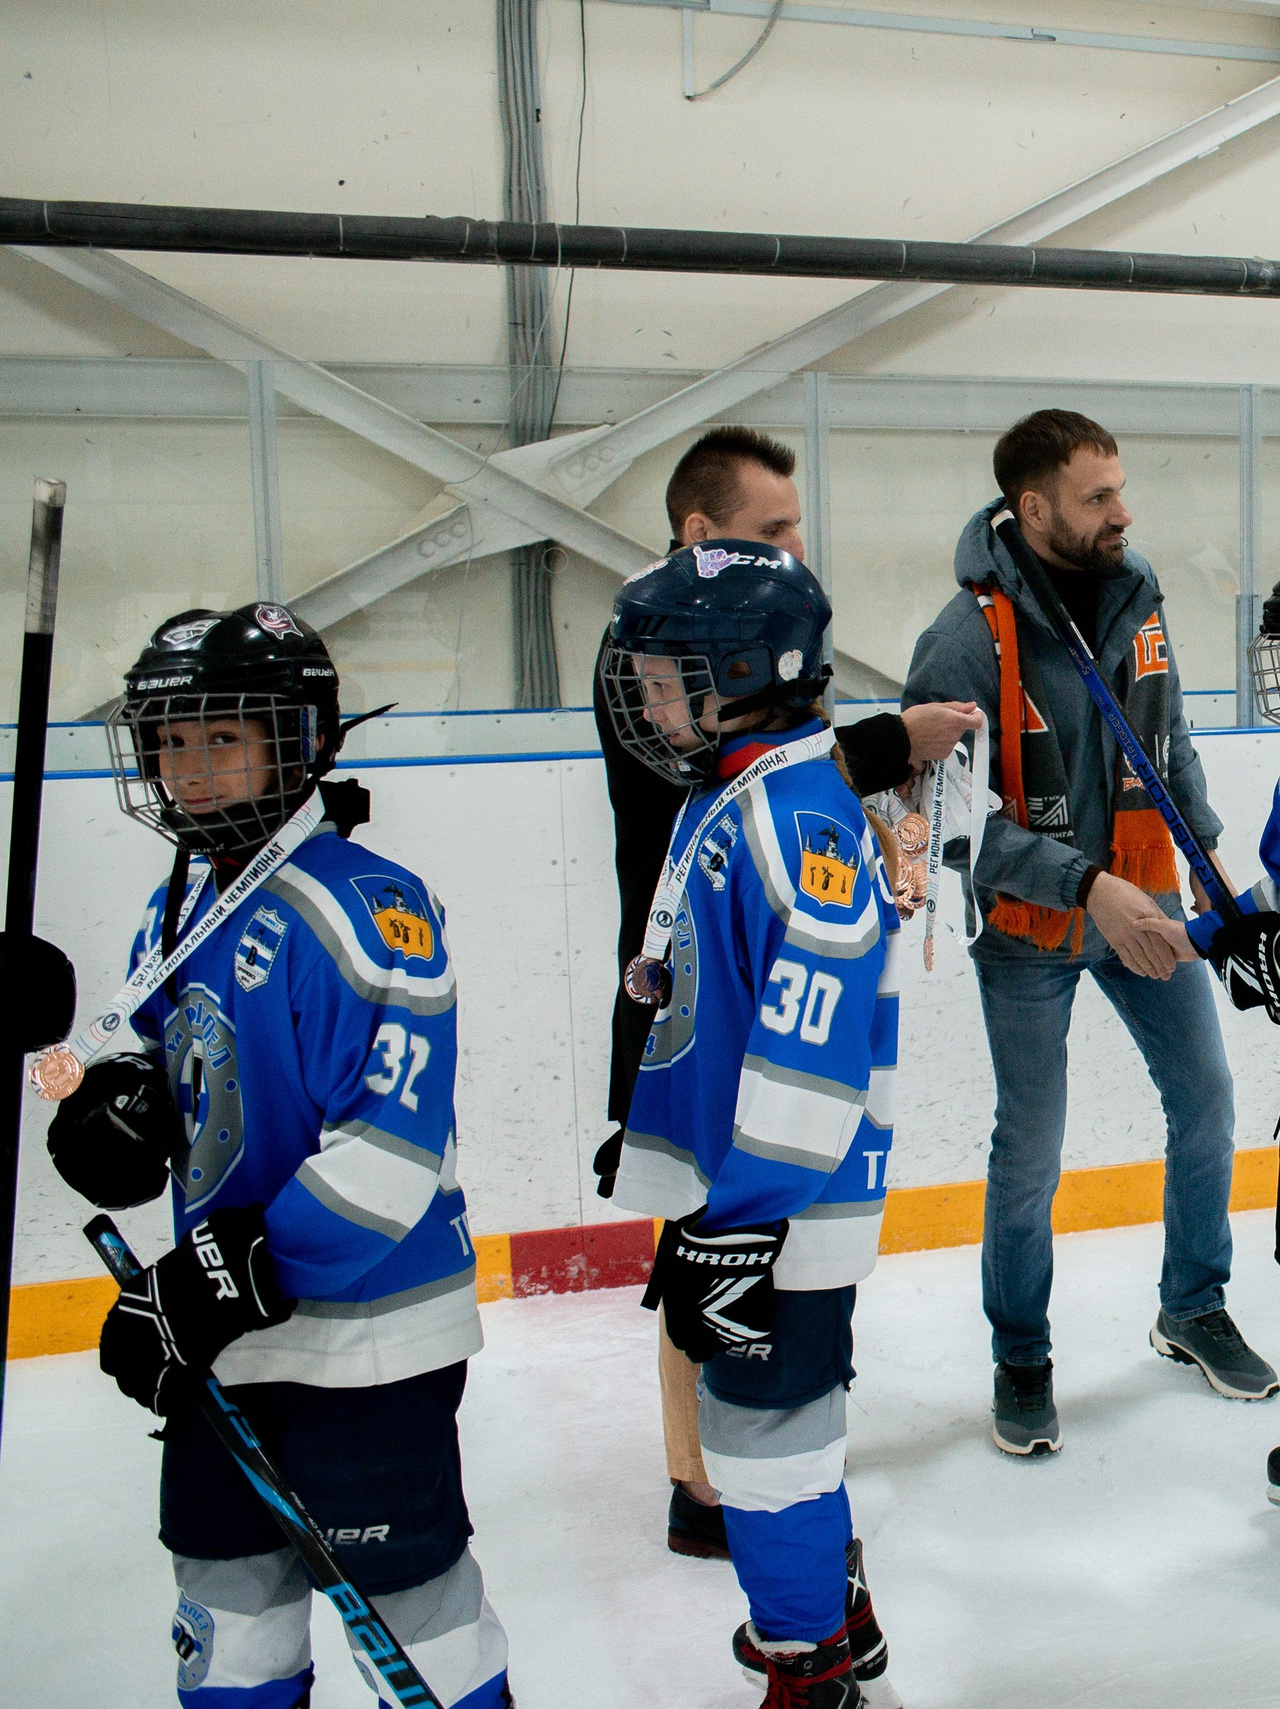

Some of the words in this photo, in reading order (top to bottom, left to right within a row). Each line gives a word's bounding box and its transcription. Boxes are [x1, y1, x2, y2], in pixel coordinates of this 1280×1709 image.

[732, 554, 783, 570] CM
[137, 675, 193, 691] BAUER
[725, 750, 789, 797] ЧЕМПИОНАТ
[1108, 712, 1138, 760] TRIGGER
[929, 801, 943, 875] РЕГИОНАЛЬНЫЙ
[936, 759, 946, 798] ЧЕМПИО
[1137, 762, 1214, 887] RIBCOR
[146, 905, 227, 990] РЕГИОНАЛЬНЫЙ
[224, 841, 286, 905] ЧЕМПИОНАТ
[760, 958, 845, 1047] 30
[191, 1222, 239, 1300] UER
[676, 1245, 773, 1266] KROK
[324, 1582, 438, 1709] BAU
